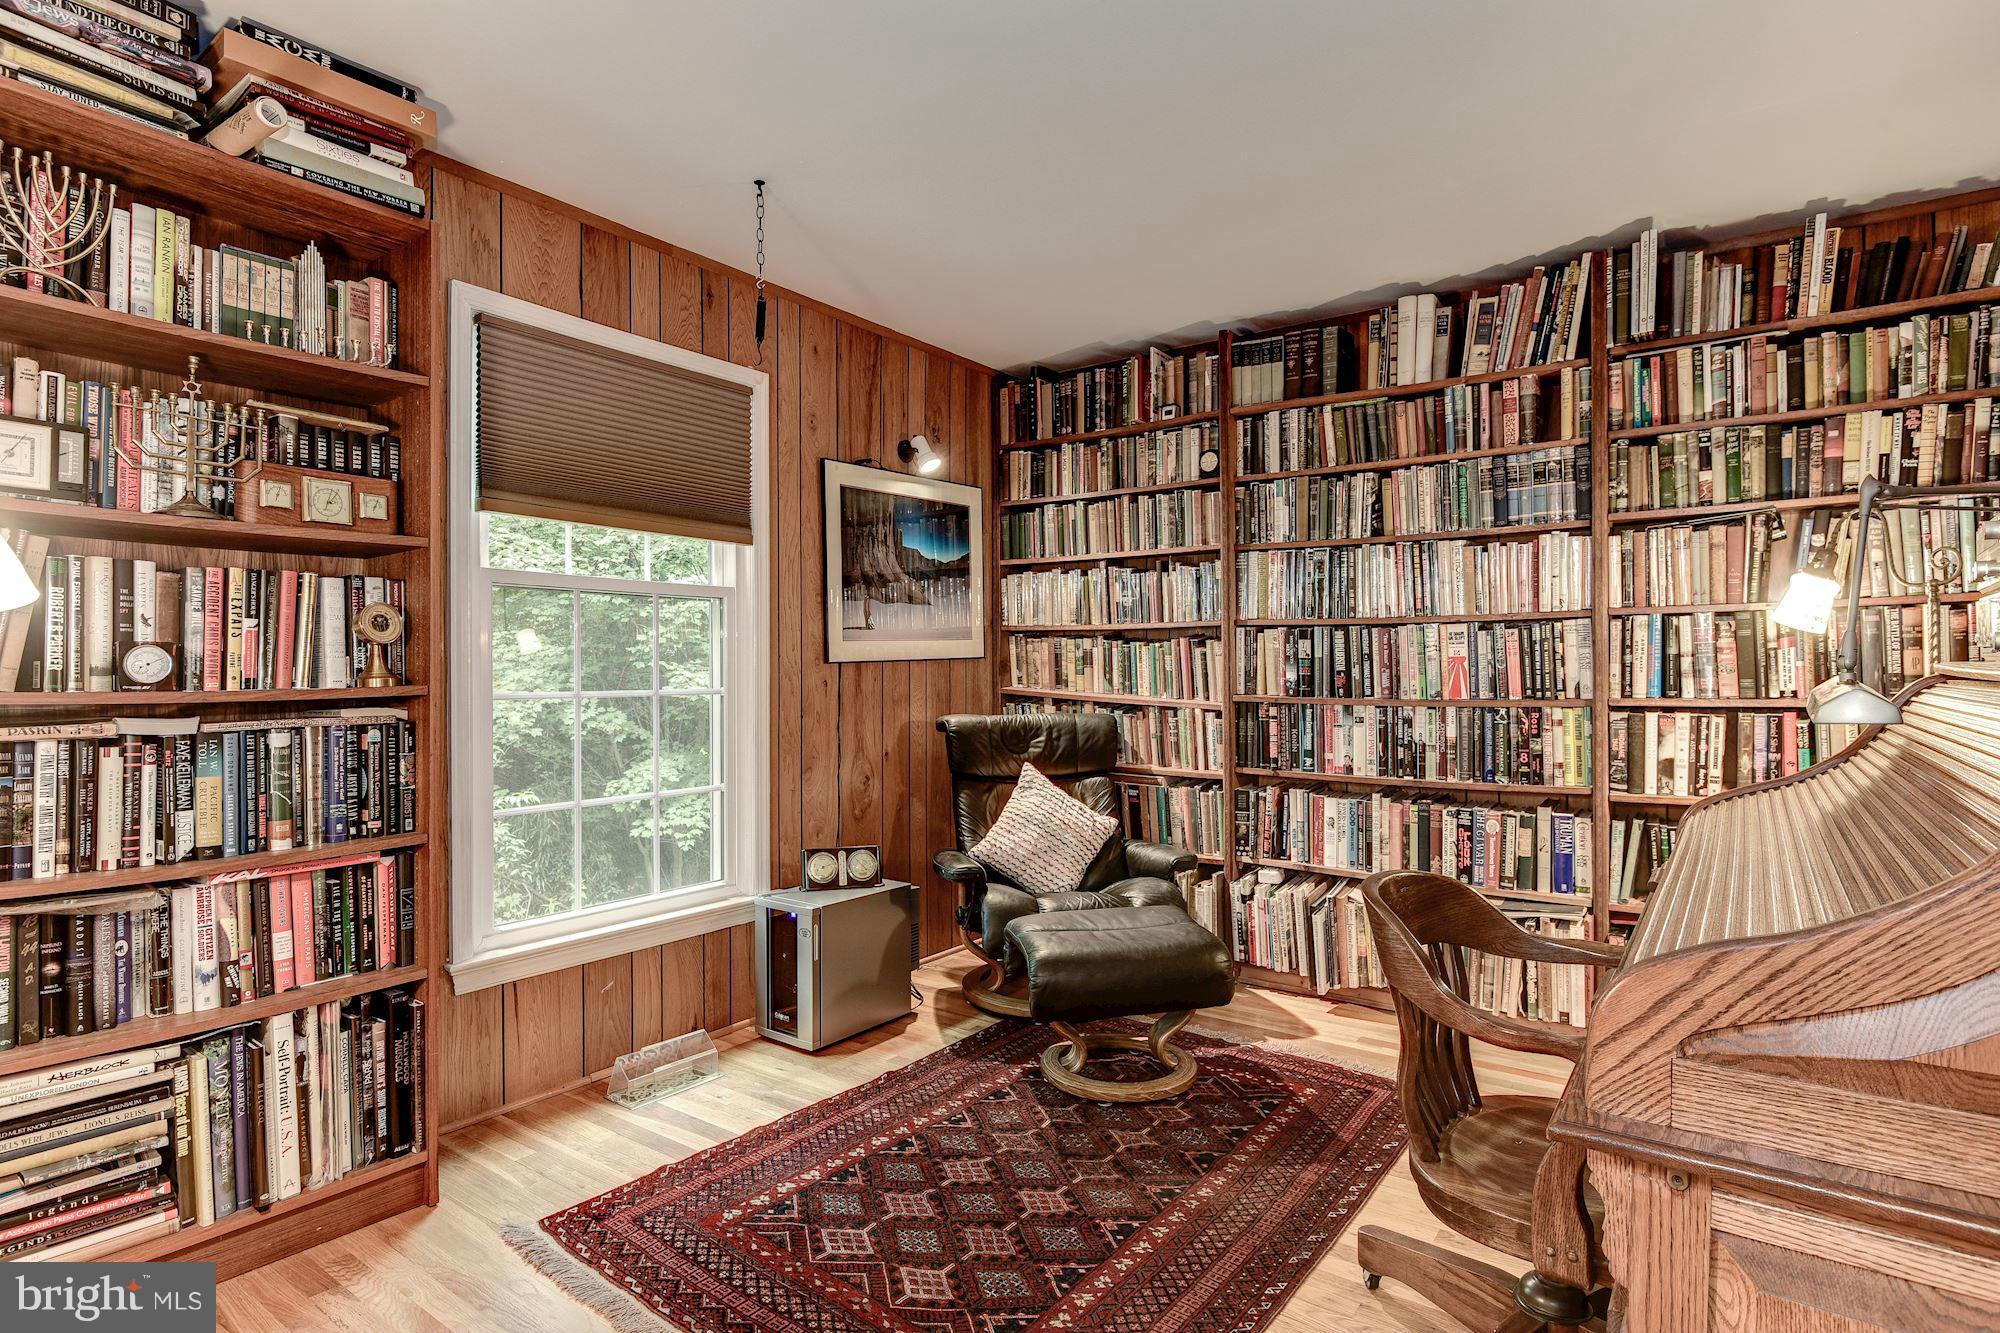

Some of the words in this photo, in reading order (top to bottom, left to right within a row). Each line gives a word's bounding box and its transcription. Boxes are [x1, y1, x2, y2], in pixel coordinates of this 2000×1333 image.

[89, 9, 119, 31] THE
[119, 19, 160, 47] CLOCK
[40, 81, 63, 97] STAY
[67, 91, 100, 109] TUNED
[123, 73, 164, 97] STARS
[167, 92, 193, 108] THE
[316, 138, 360, 162] Sixties
[306, 171, 344, 188] COVERING
[347, 182, 360, 192] THE
[362, 187, 380, 198] NEW
[382, 192, 409, 206] YORKER
[162, 217, 171, 234] IAN
[161, 237, 171, 273] RANKIN
[1917, 351, 1927, 368] SHORT
[1917, 369, 1928, 384] TAKES
[88, 385, 98, 414] THOSE
[1459, 478, 1468, 519] DELIVERANCE
[72, 561, 81, 578] PAUL
[210, 570, 219, 579] THE
[72, 581, 81, 610] FUSSELL
[137, 571, 146, 609] HARRIS
[191, 585, 202, 609] SAVAGE
[207, 580, 219, 619] ACCIDENT
[48, 587, 64, 624] ROBERT
[231, 597, 242, 638] EXPATS
[1891, 608, 1899, 621] THE
[191, 612, 202, 628] WILL
[1891, 622, 1900, 641] BATTLE
[207, 621, 219, 647] CHRIS
[48, 634, 63, 670] PARKER
[206, 648, 219, 680] PAVONE
[1891, 650, 1901, 674] BRITAIN
[7, 725, 63, 736] PASKIN
[1368, 712, 1376, 738] GORKY
[1531, 712, 1540, 734] Rosa
[1770, 717, 1779, 736] Daniel
[59, 744, 68, 759] ALAN
[176, 740, 192, 761] FAYE
[209, 739, 218, 758] IAN
[1543, 730, 1552, 749] SOUL
[1618, 729, 1626, 758] ENDGAME
[1770, 737, 1779, 753] Silva
[39, 754, 54, 771] FINAL
[198, 742, 207, 768] TOLL
[209, 760, 218, 772] W.
[57, 760, 68, 779] FURST
[39, 772, 54, 799] COUNTRY
[86, 783, 94, 811] BUNKER
[177, 762, 193, 809] KELLERMAN
[39, 804, 54, 824] JAMES
[124, 797, 132, 831] PAPERBOY
[199, 781, 207, 828] CRUCIBLE
[247, 800, 255, 810] DAN
[177, 814, 193, 845] JUSTICE
[247, 811, 255, 836] KURZMAN
[1476, 810, 1484, 828] THE
[38, 825, 53, 854] CRUMLEY
[1560, 818, 1572, 854] TRUMAN
[1577, 822, 1589, 850] Creation
[1475, 843, 1485, 865] WAR
[196, 887, 205, 925] AMBROSE
[204, 886, 213, 917] STEPHEN
[151, 911, 159, 934] WERE
[160, 912, 168, 928] THE
[102, 943, 110, 968] TODD
[158, 929, 169, 959] THINGS
[197, 929, 205, 962] SOLDIERS
[205, 928, 213, 961] CITIZEN
[236, 1036, 244, 1053] THE
[341, 1037, 349, 1072] CORNELL
[376, 1040, 385, 1062] IRVING
[236, 1053, 244, 1071] JEWS
[394, 1039, 402, 1083] MUSICALS
[402, 1031, 410, 1085] HOLLYWOOD
[47, 1059, 130, 1084] HERBLOCK
[174, 1066, 188, 1093] KARSH
[237, 1072, 244, 1081] IN
[276, 1040, 292, 1115] Self-Portrait:
[376, 1062, 386, 1089] BERLIN'S
[10, 1084, 65, 1103] UNEXPLORED
[65, 1077, 100, 1092] LONDON
[214, 1060, 230, 1121] MONET
[237, 1082, 245, 1118] AMERICA
[377, 1090, 387, 1107] SHOW
[175, 1093, 187, 1117] Faces
[257, 1083, 265, 1126] BELLOCQ
[84, 1116, 114, 1130] LIONEL
[115, 1115, 121, 1123] S.
[124, 1108, 147, 1120] REISS
[176, 1118, 188, 1126] of
[176, 1126, 188, 1136] our
[378, 1109, 387, 1138] BUSINESS
[21, 1135, 46, 1146] WERE
[46, 1128, 69, 1139] JEWS
[177, 1136, 190, 1157] Time
[280, 1116, 294, 1158] U.S.A.
[7, 1217, 53, 1238] ASSOCIATED
[53, 1211, 75, 1228] PRESS
[76, 1203, 105, 1217] COVERS
[106, 1200, 120, 1210] THE
[120, 1193, 146, 1205] WORLD
[28, 1195, 99, 1221] legends
